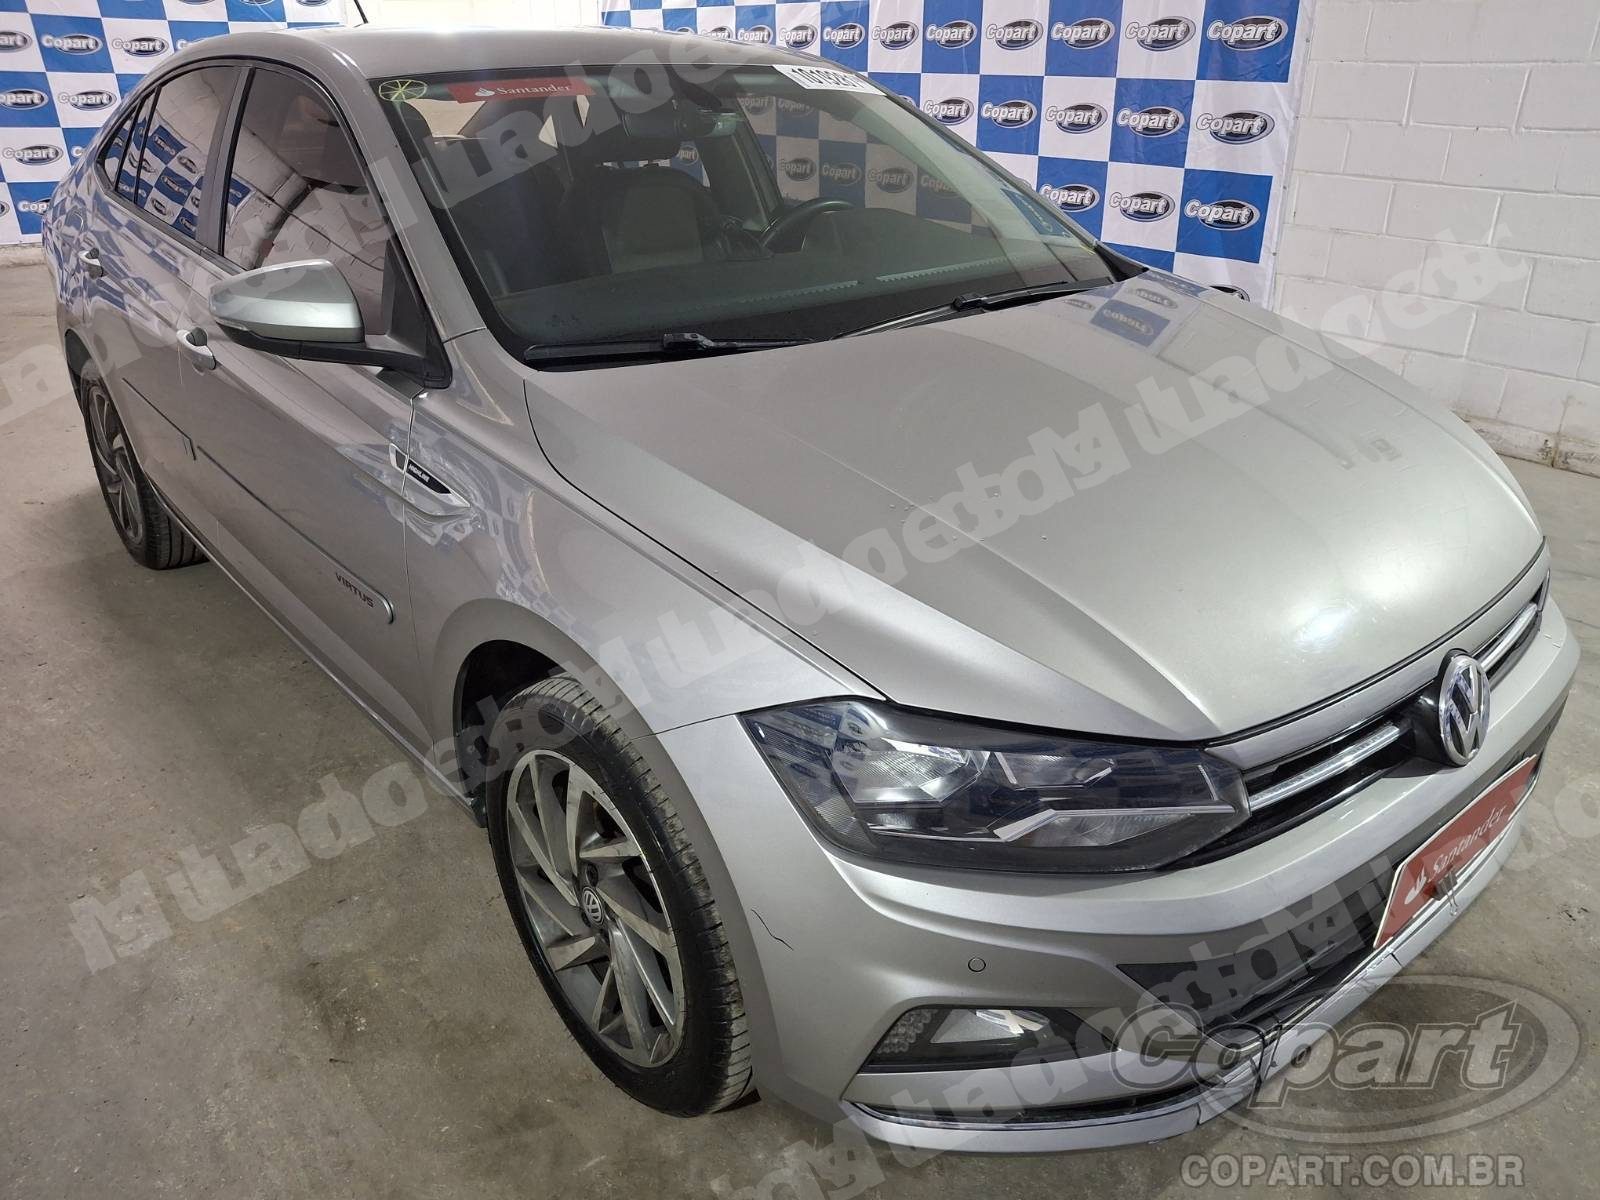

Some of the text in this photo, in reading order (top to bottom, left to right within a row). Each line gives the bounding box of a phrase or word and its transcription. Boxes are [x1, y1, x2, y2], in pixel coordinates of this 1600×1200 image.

[738, 29, 769, 42] Copart
[779, 28, 812, 46] Copart
[822, 26, 860, 44] Copart
[872, 26, 913, 42] Copart
[926, 24, 972, 43] Copart
[986, 24, 1036, 44] Copart
[1050, 22, 1106, 45] Copart
[1125, 21, 1189, 44] Copart
[1207, 20, 1278, 44] Copart
[42, 35, 96, 51] Copart
[112, 39, 162, 52] Copart
[0, 93, 41, 106] opart
[58, 92, 109, 106] Copart
[497, 84, 572, 95] Santander
[923, 100, 968, 120] Copart
[981, 102, 1030, 122] Copart
[1046, 107, 1100, 127] Copart
[1117, 108, 1179, 130] Copart
[1196, 114, 1264, 136] Copart
[3, 147, 57, 162] Copart
[822, 163, 857, 179] Copart
[1040, 184, 1091, 206] Copart
[1109, 192, 1167, 215] Copart
[18, 201, 50, 213] Cop
[1185, 199, 1250, 223] Copart
[335, 572, 374, 608] VIRTUS
[1432, 805, 1507, 874] Santander
